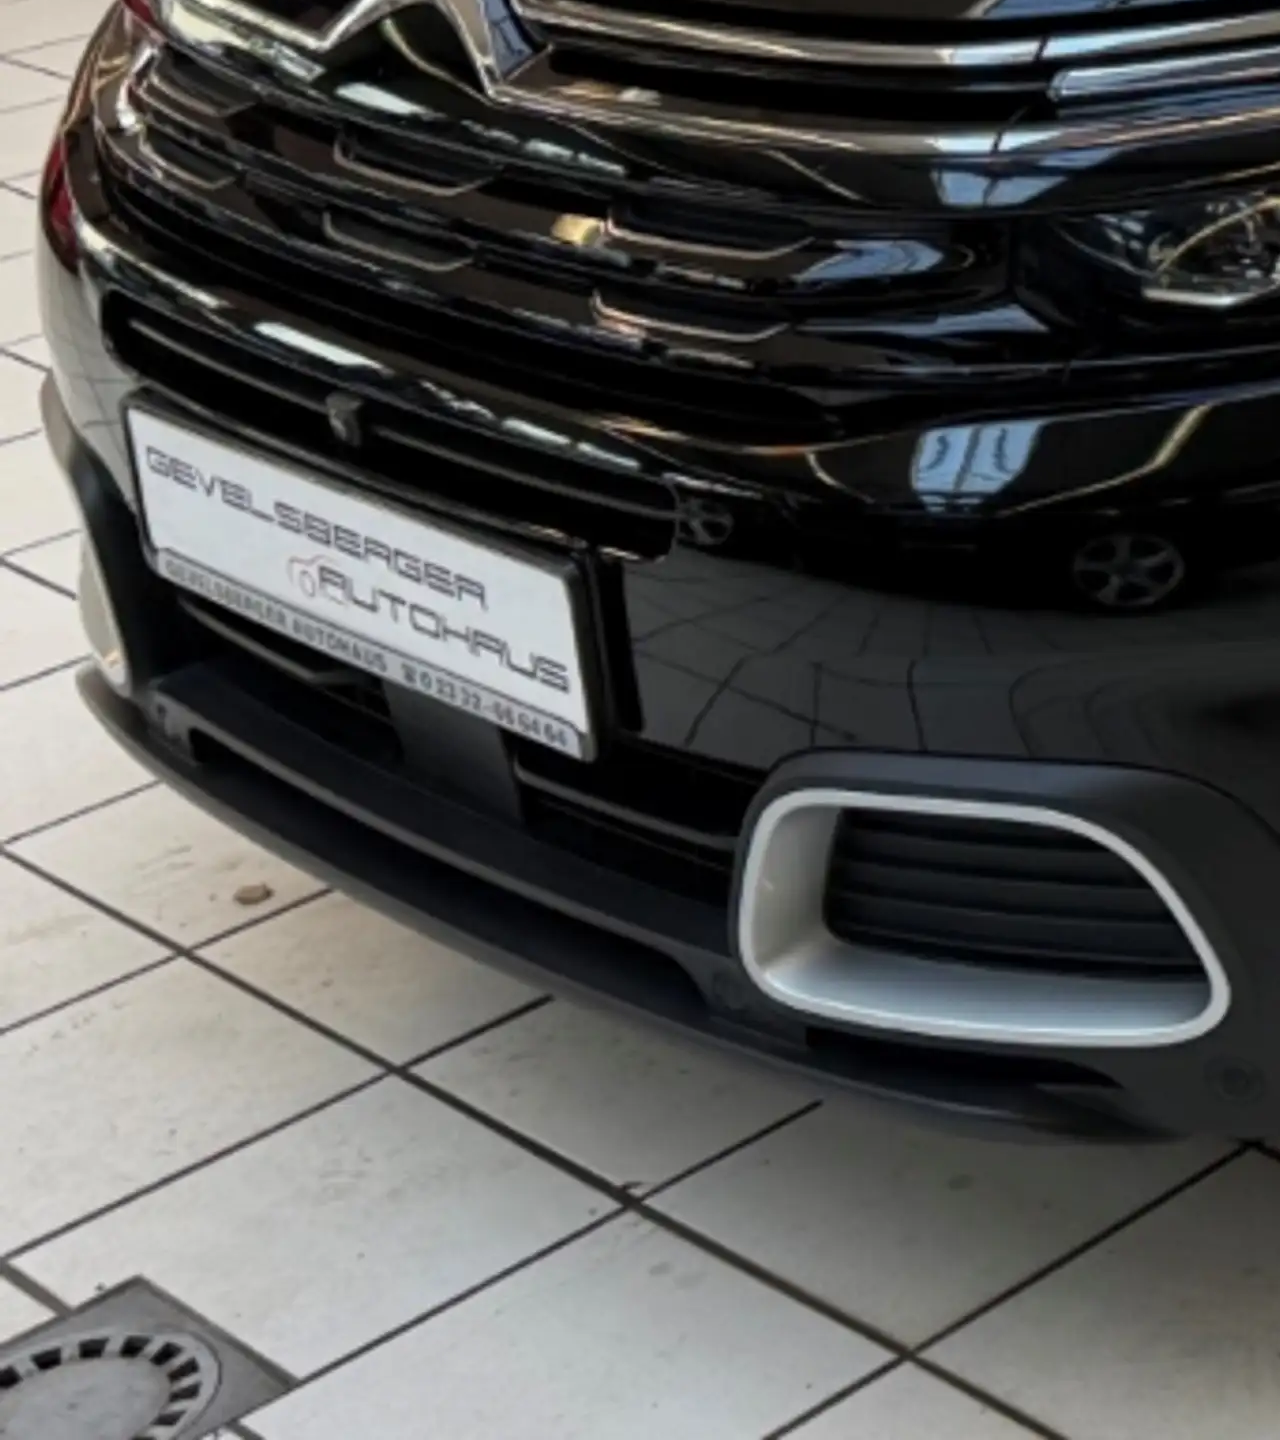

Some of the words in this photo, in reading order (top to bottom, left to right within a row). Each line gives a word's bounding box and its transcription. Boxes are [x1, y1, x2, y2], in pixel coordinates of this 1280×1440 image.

[146, 445, 489, 611] GEVELSBERGER
[165, 559, 288, 628] GEVELSBERGER
[291, 617, 388, 674] AUTOHAUS
[317, 563, 570, 694] AUTOHAUS
